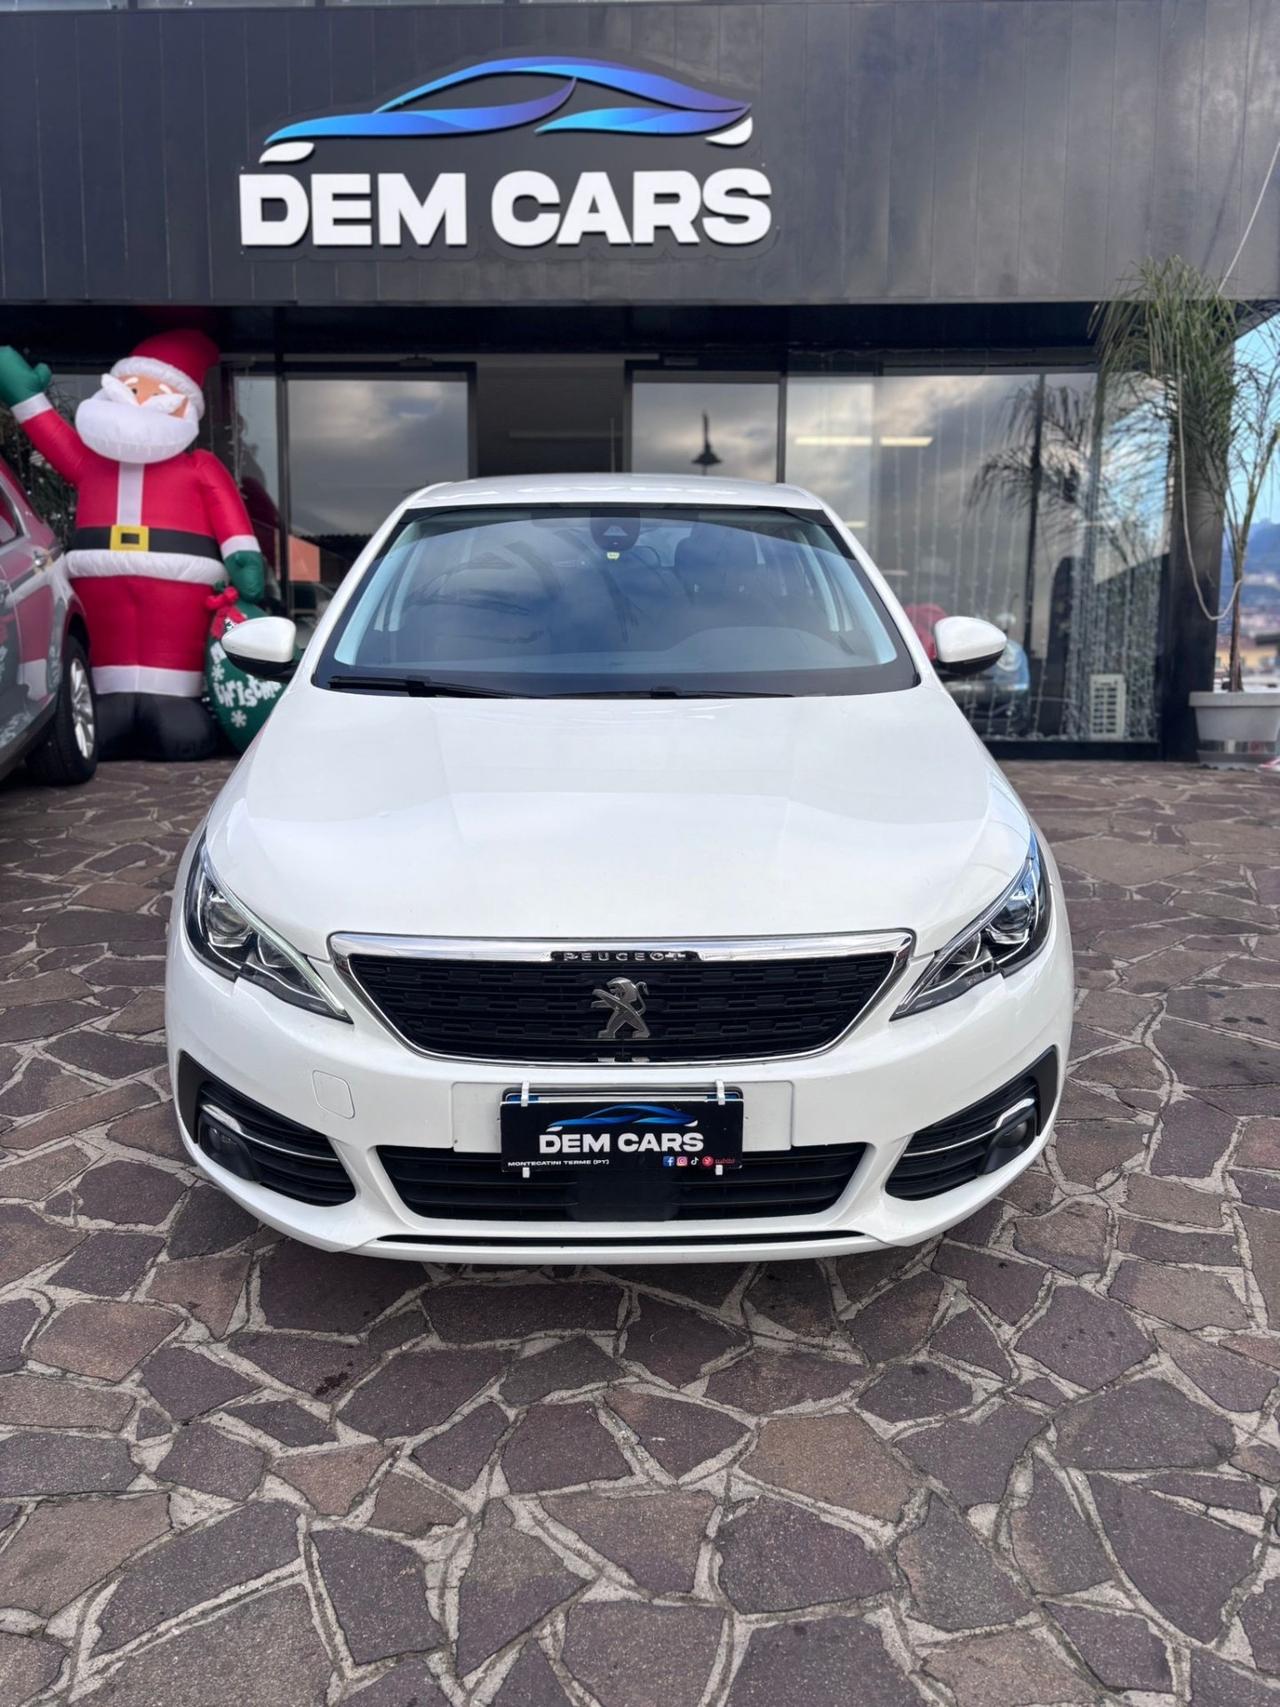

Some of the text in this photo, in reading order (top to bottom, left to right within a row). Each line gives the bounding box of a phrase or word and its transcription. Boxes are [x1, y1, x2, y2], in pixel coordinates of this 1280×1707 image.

[239, 168, 772, 246] DEM CARS
[538, 1132, 705, 1154] DEM CARS
